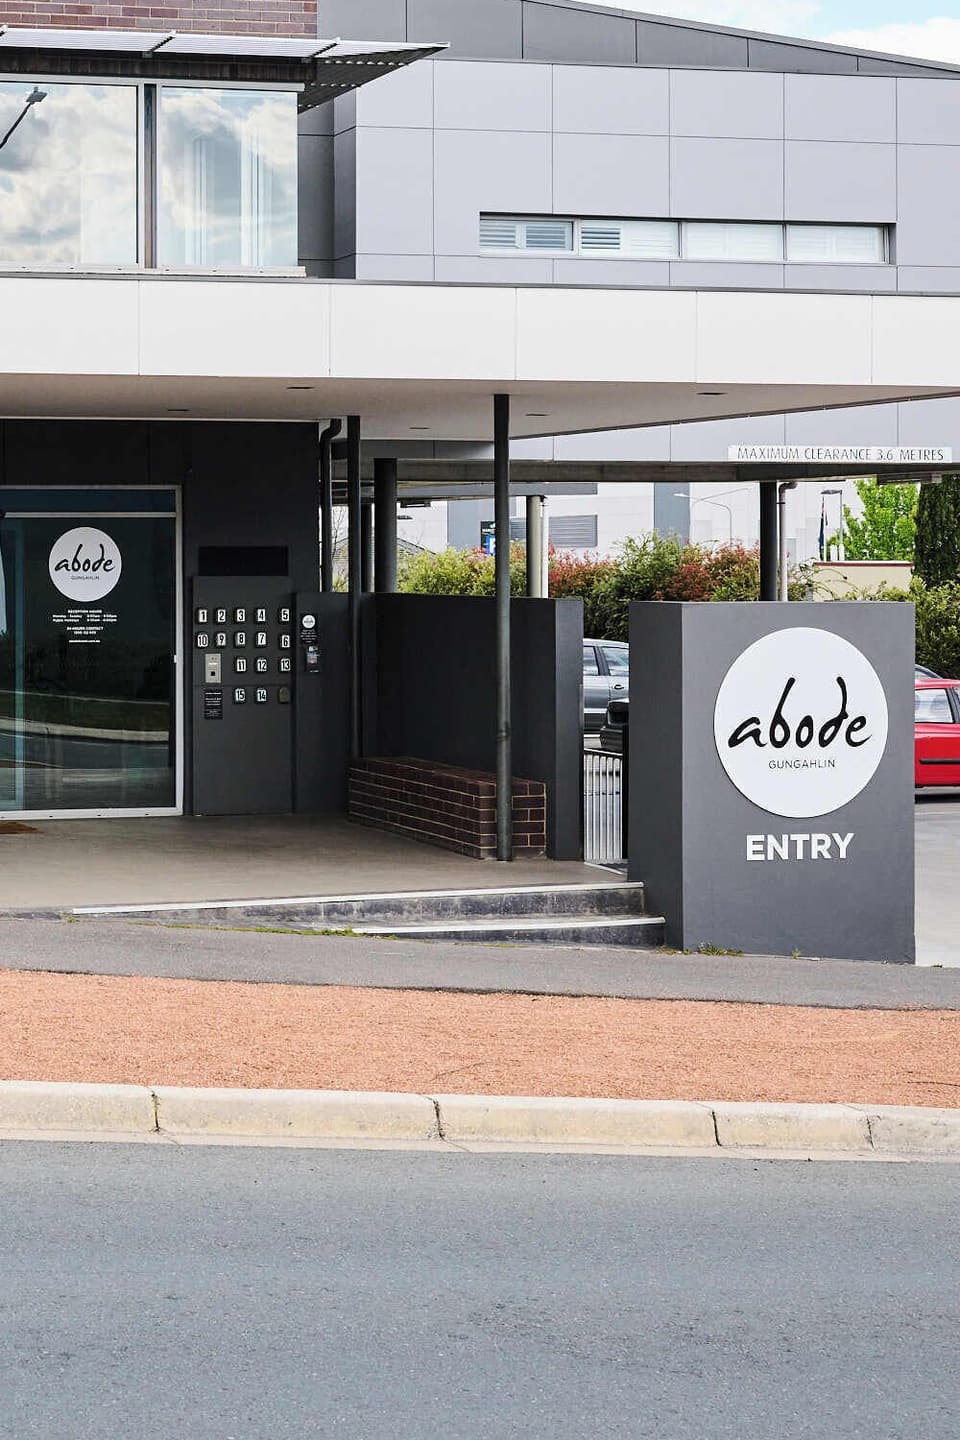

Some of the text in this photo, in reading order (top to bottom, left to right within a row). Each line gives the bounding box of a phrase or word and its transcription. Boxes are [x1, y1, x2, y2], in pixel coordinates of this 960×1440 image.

[737, 447, 944, 461] MAXIMUM CLEARANCE 3.6 METRES
[54, 544, 116, 572] abode
[198, 635, 208, 646] 10
[238, 660, 246, 671] 11
[258, 660, 267, 671] 12
[281, 659, 290, 671] 13
[236, 689, 245, 700] 15
[257, 690, 266, 701] 14
[728, 676, 873, 749] abode
[768, 759, 836, 769] GUNGAHLIN
[745, 832, 855, 862] ENTRY
